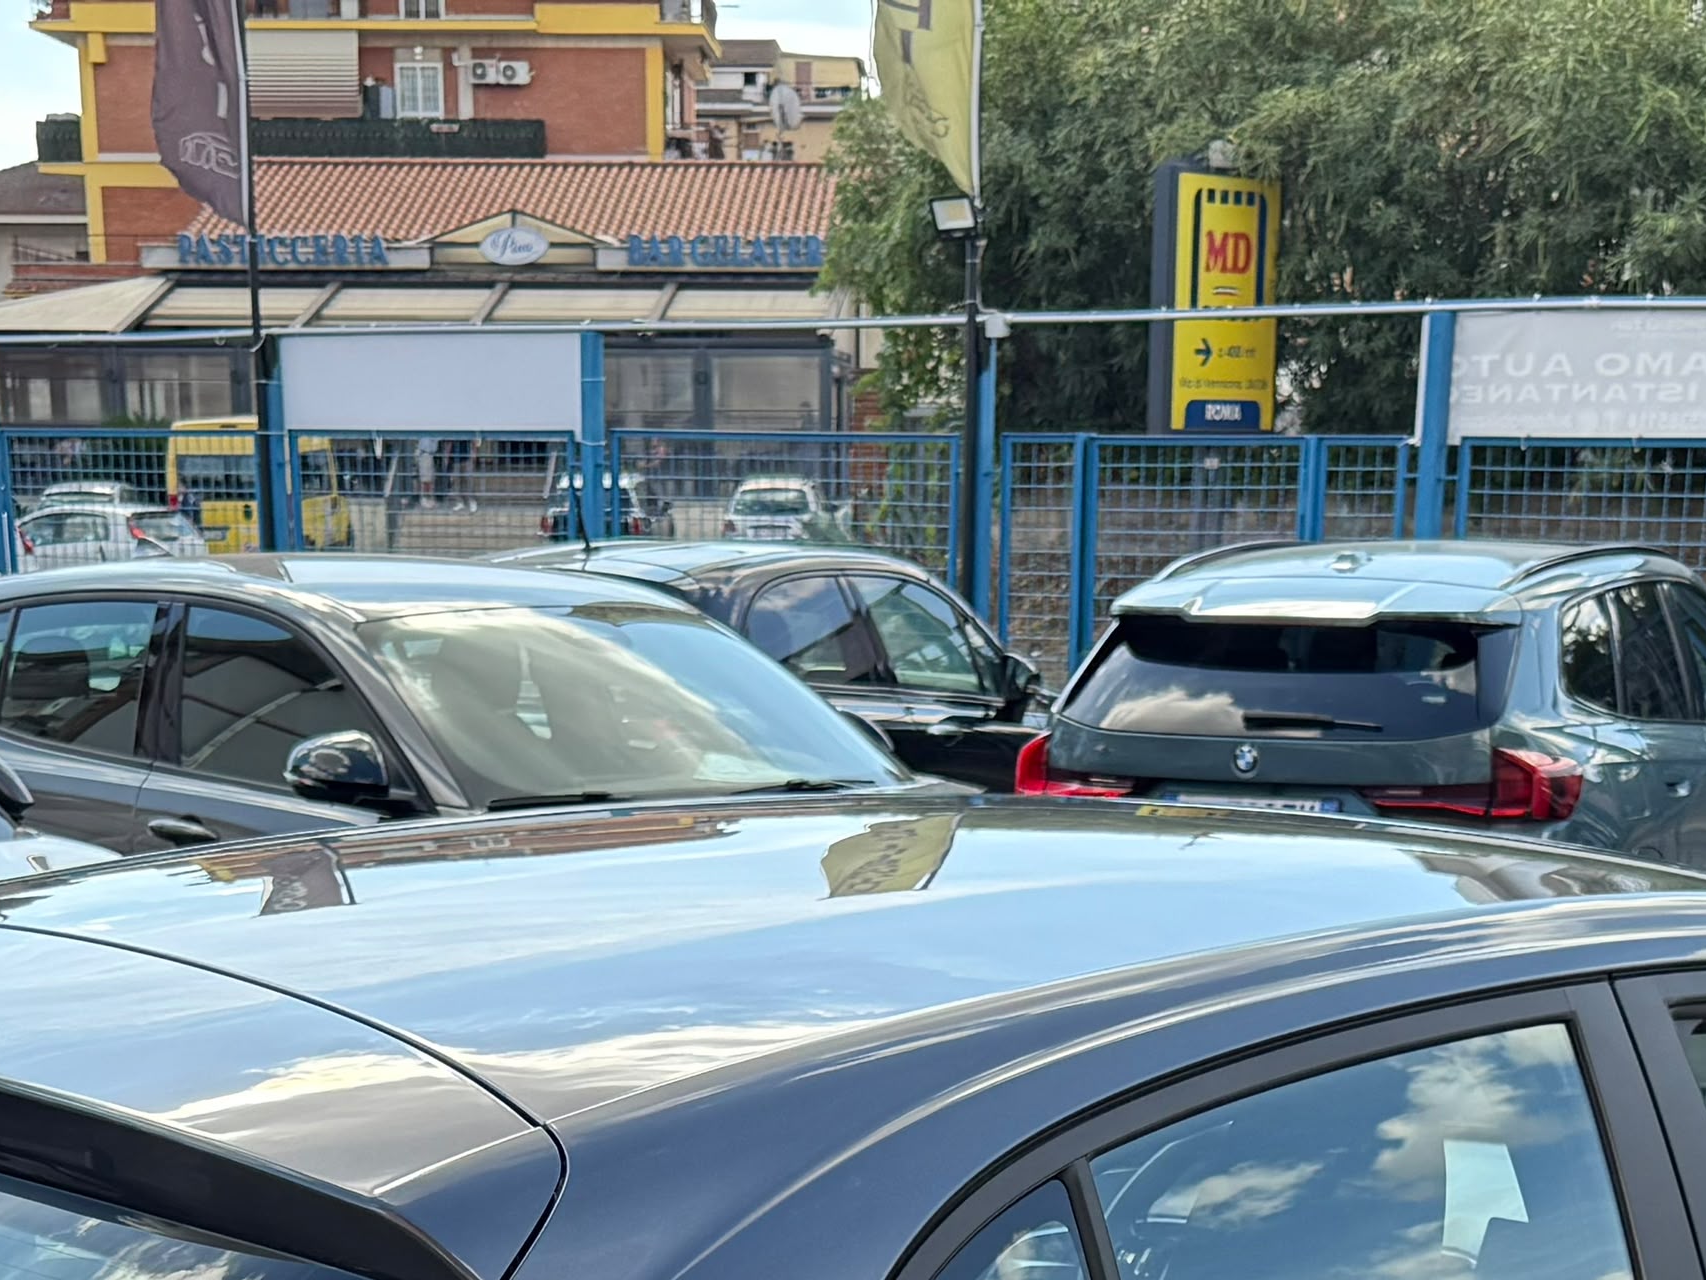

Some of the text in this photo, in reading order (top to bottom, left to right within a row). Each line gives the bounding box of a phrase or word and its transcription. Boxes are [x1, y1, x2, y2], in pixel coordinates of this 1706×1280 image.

[177, 232, 390, 266] PASTICCERIA
[628, 233, 824, 267] BAR GELATER
[1204, 229, 1254, 275] MD
